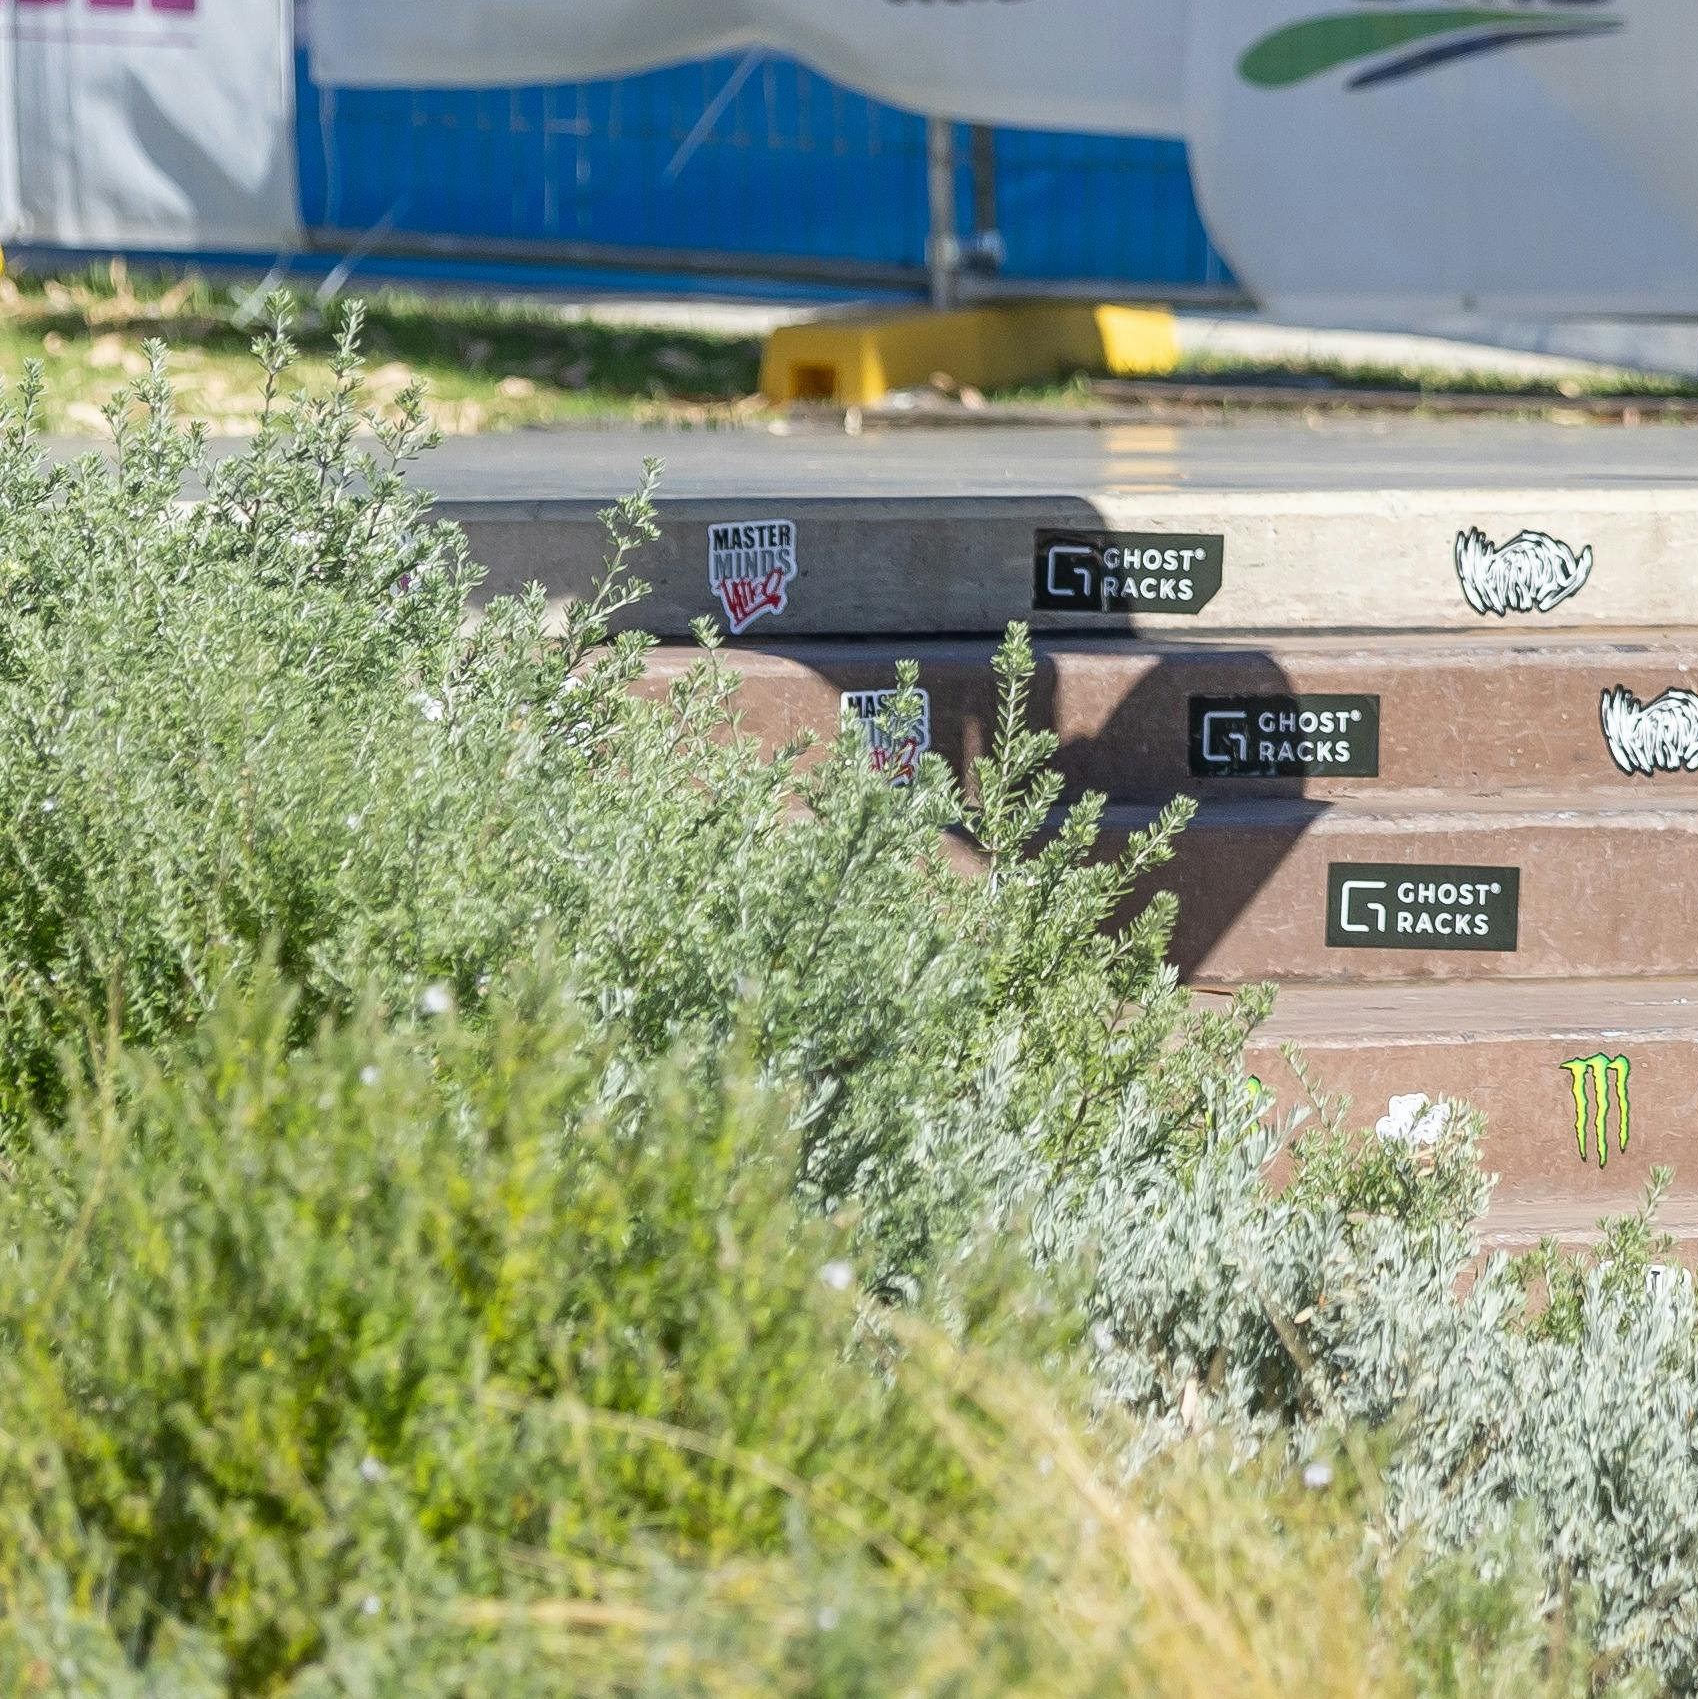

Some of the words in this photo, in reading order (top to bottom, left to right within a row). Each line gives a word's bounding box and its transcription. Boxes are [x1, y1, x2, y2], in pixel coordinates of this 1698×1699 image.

[713, 525, 791, 551] MASTER
[713, 549, 791, 580] MINDS
[1103, 577, 1194, 601] RACKS
[1259, 740, 1351, 763] RACKS
[1397, 912, 1490, 935] RACKS
